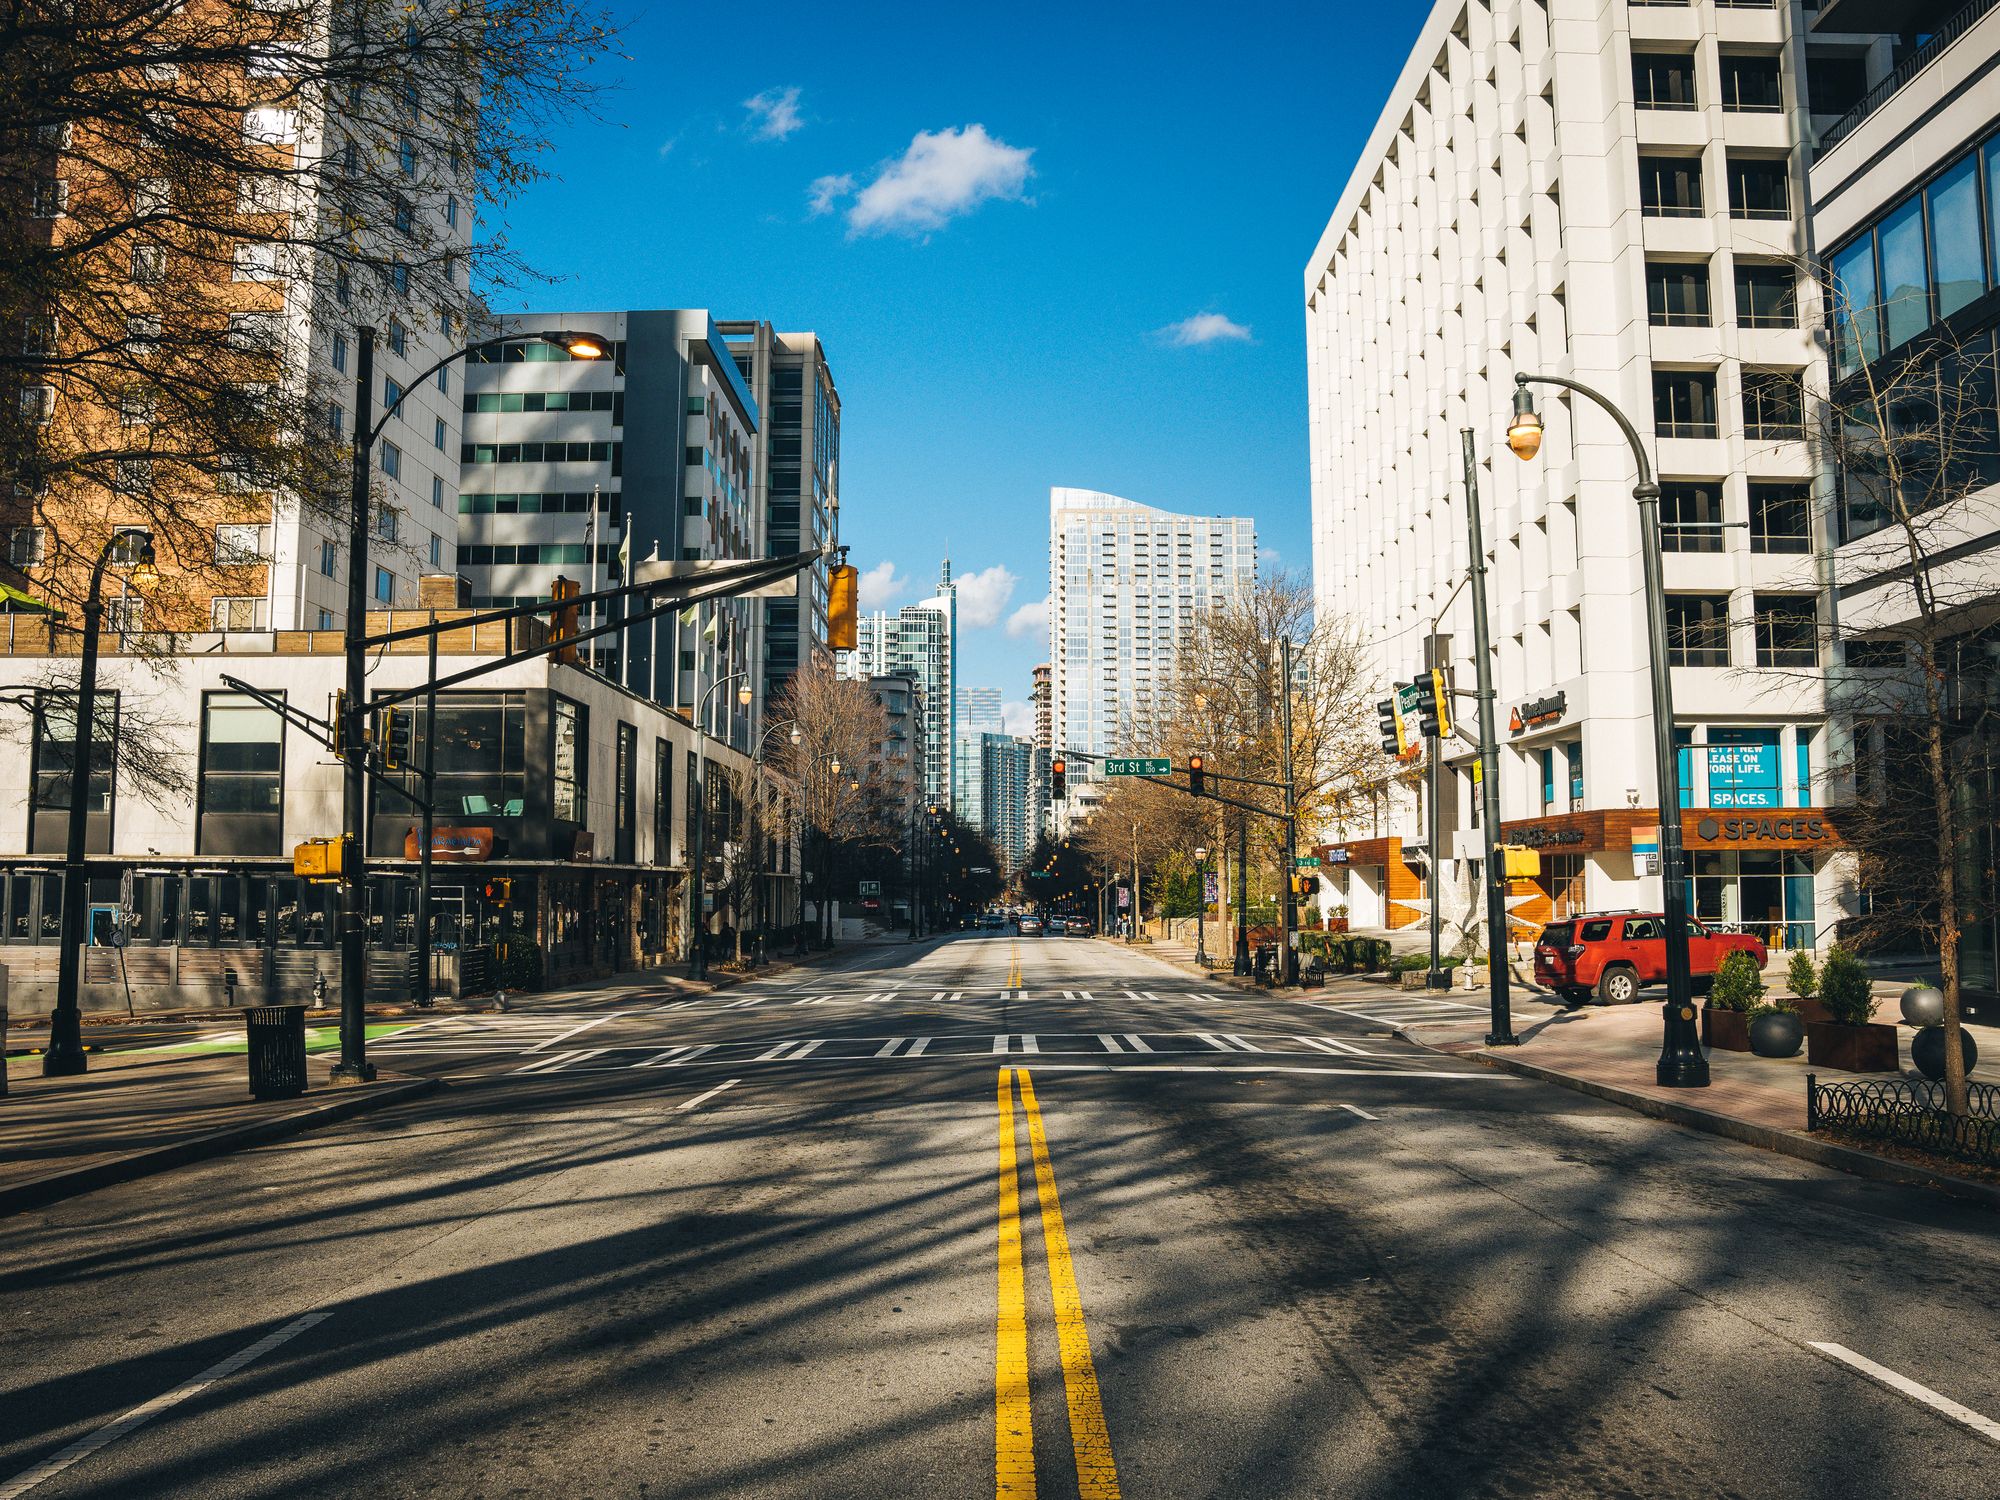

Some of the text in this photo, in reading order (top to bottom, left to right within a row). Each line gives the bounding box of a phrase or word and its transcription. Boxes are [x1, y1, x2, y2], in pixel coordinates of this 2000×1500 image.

[1709, 754, 1758, 763] EASE ON
[1108, 761, 1140, 773] 3rd St
[1709, 764, 1764, 773] ORK LIFE.
[1713, 793, 1769, 805] SPACES.
[1724, 818, 1830, 840] SPACES.
